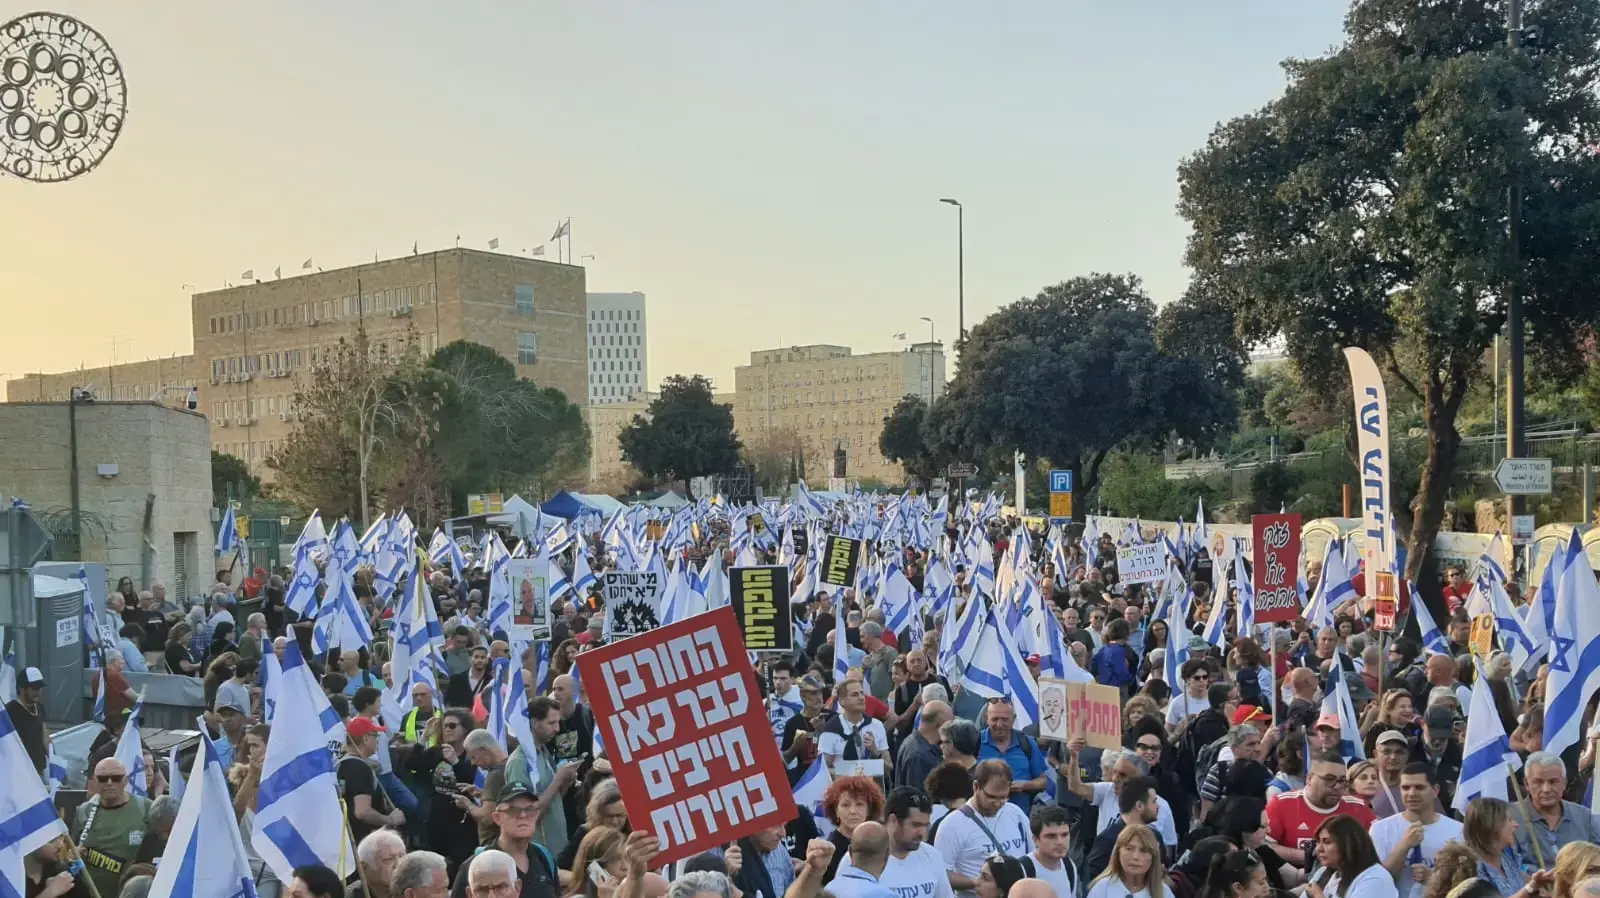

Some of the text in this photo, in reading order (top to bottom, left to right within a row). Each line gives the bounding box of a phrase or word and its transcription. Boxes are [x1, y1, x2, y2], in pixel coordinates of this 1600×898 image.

[607, 573, 657, 585] מי שהרס
[1130, 556, 1154, 568] הורג
[1153, 568, 1165, 577] את
[1265, 552, 1286, 585] ארץ
[609, 585, 657, 599] לא יתקן
[742, 569, 777, 648] הופקרנו!
[600, 625, 729, 712] החורבן
[675, 672, 749, 729] כבר
[608, 697, 676, 764] כאן
[638, 725, 755, 800] חייבים
[650, 772, 778, 851] בחירות
[920, 881, 935, 895] יש
